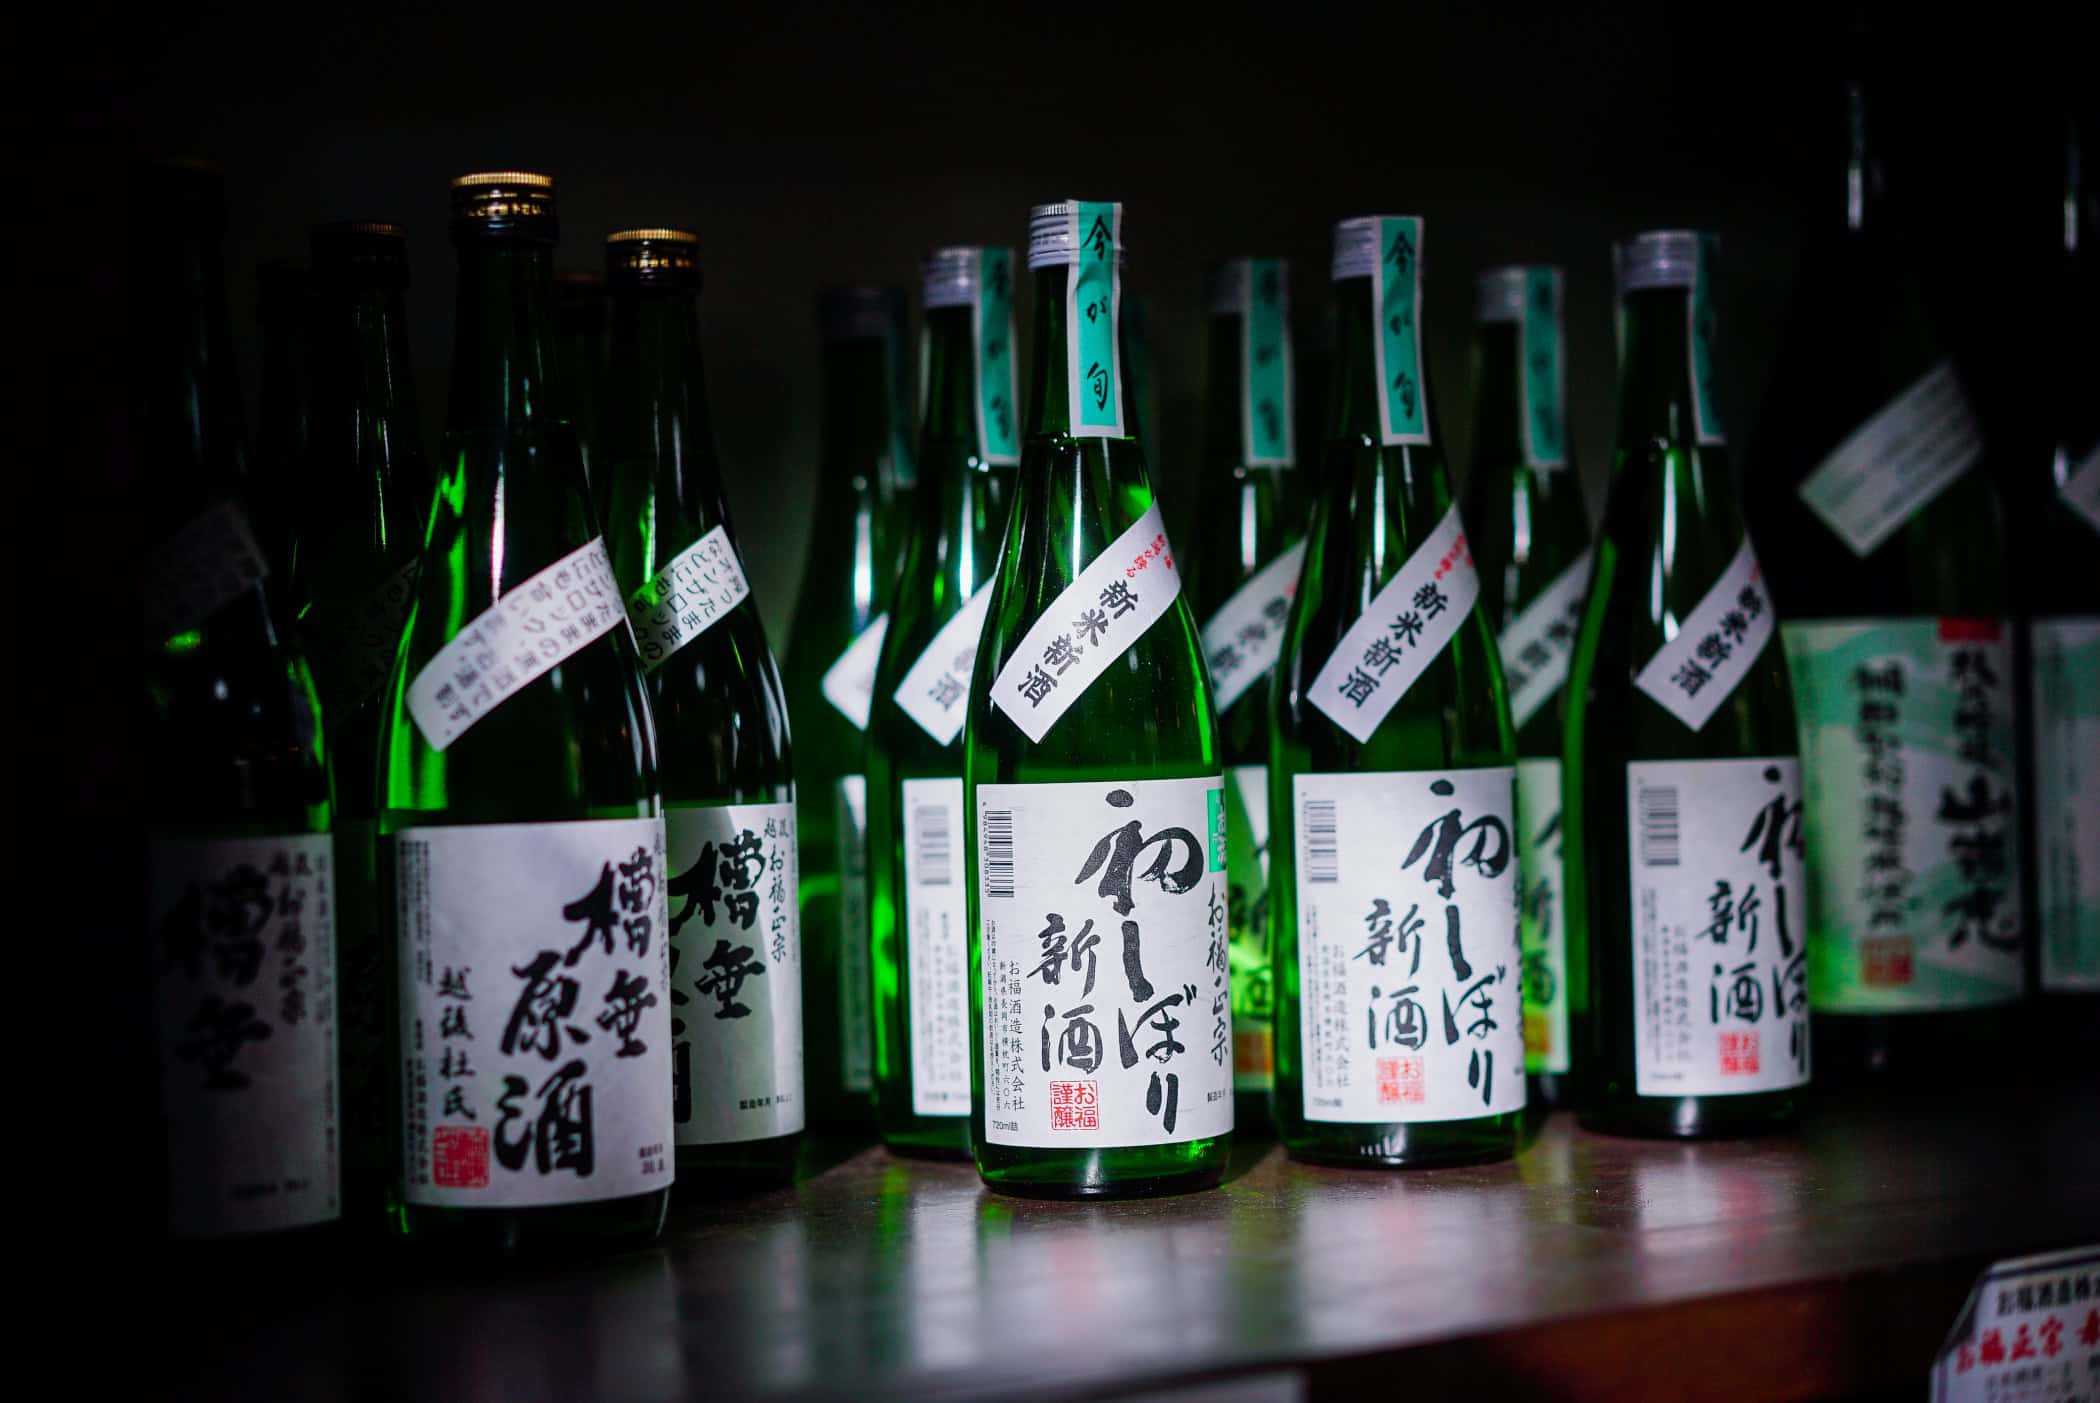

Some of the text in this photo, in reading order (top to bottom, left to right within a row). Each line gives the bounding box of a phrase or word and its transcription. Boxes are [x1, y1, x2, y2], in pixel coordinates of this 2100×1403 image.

[1082, 214, 1113, 412] 今が旬
[1386, 230, 1416, 421] 今が旬
[1017, 579, 1139, 708] 新米新酒
[1338, 582, 1448, 708] 新米新酒
[1027, 913, 1104, 1075] 新酒
[1074, 788, 1205, 1135] 初しぼり
[1352, 899, 1429, 1051] 新酒
[1401, 779, 1511, 1107] 初しぼり
[1695, 880, 1764, 1025] 新酒
[493, 950, 594, 1178] 原酒
[1008, 960, 1026, 1111] お福酒造株式会社
